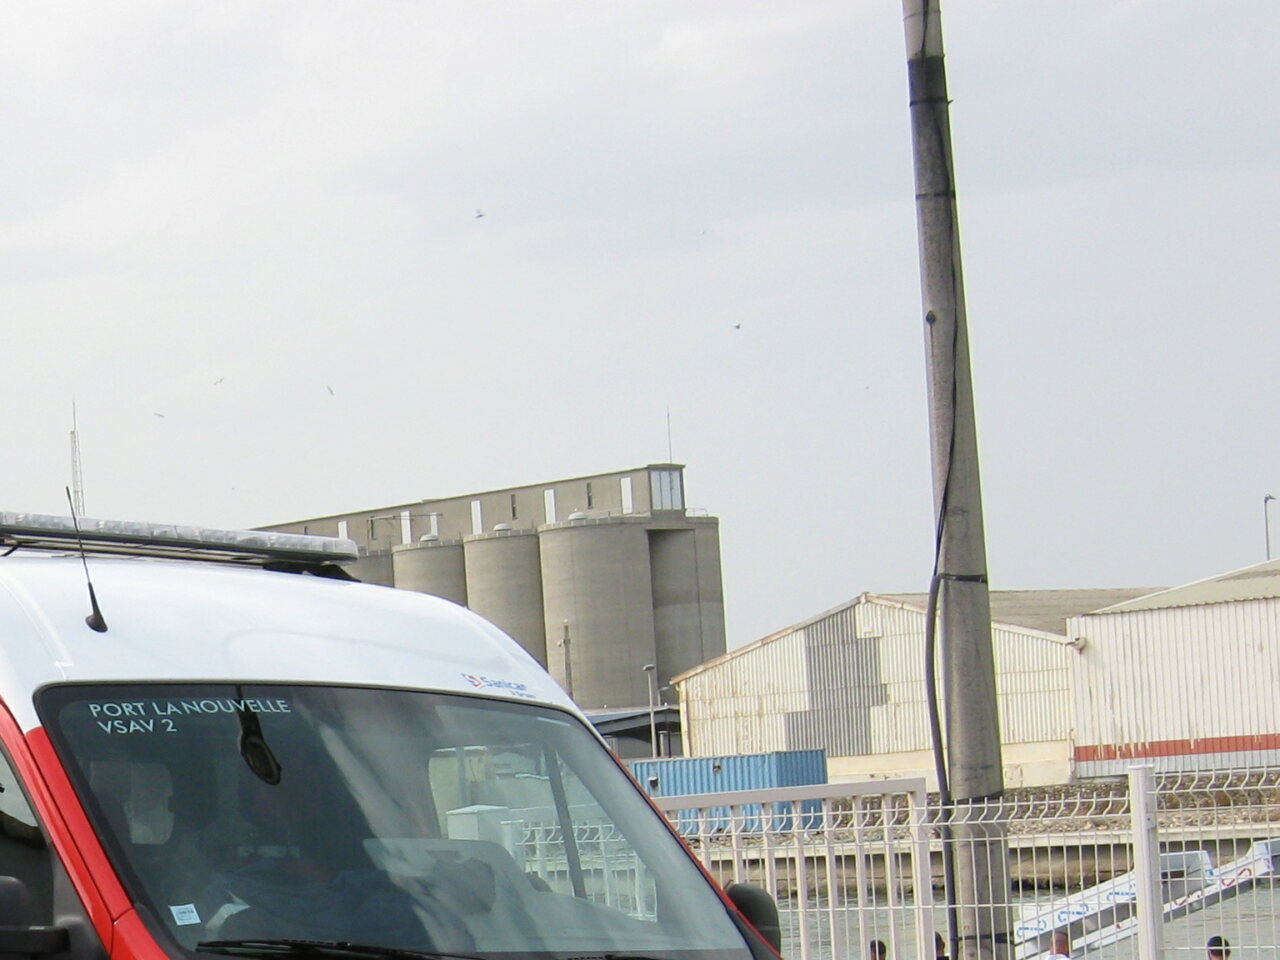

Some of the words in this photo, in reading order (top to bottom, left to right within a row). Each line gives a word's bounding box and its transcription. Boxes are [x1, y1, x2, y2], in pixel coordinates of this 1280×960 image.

[88, 702, 145, 718] PORT
[152, 701, 181, 716] LA
[181, 699, 291, 714] NOUVELLE
[97, 719, 154, 734] VSAV
[161, 719, 177, 732] 2
